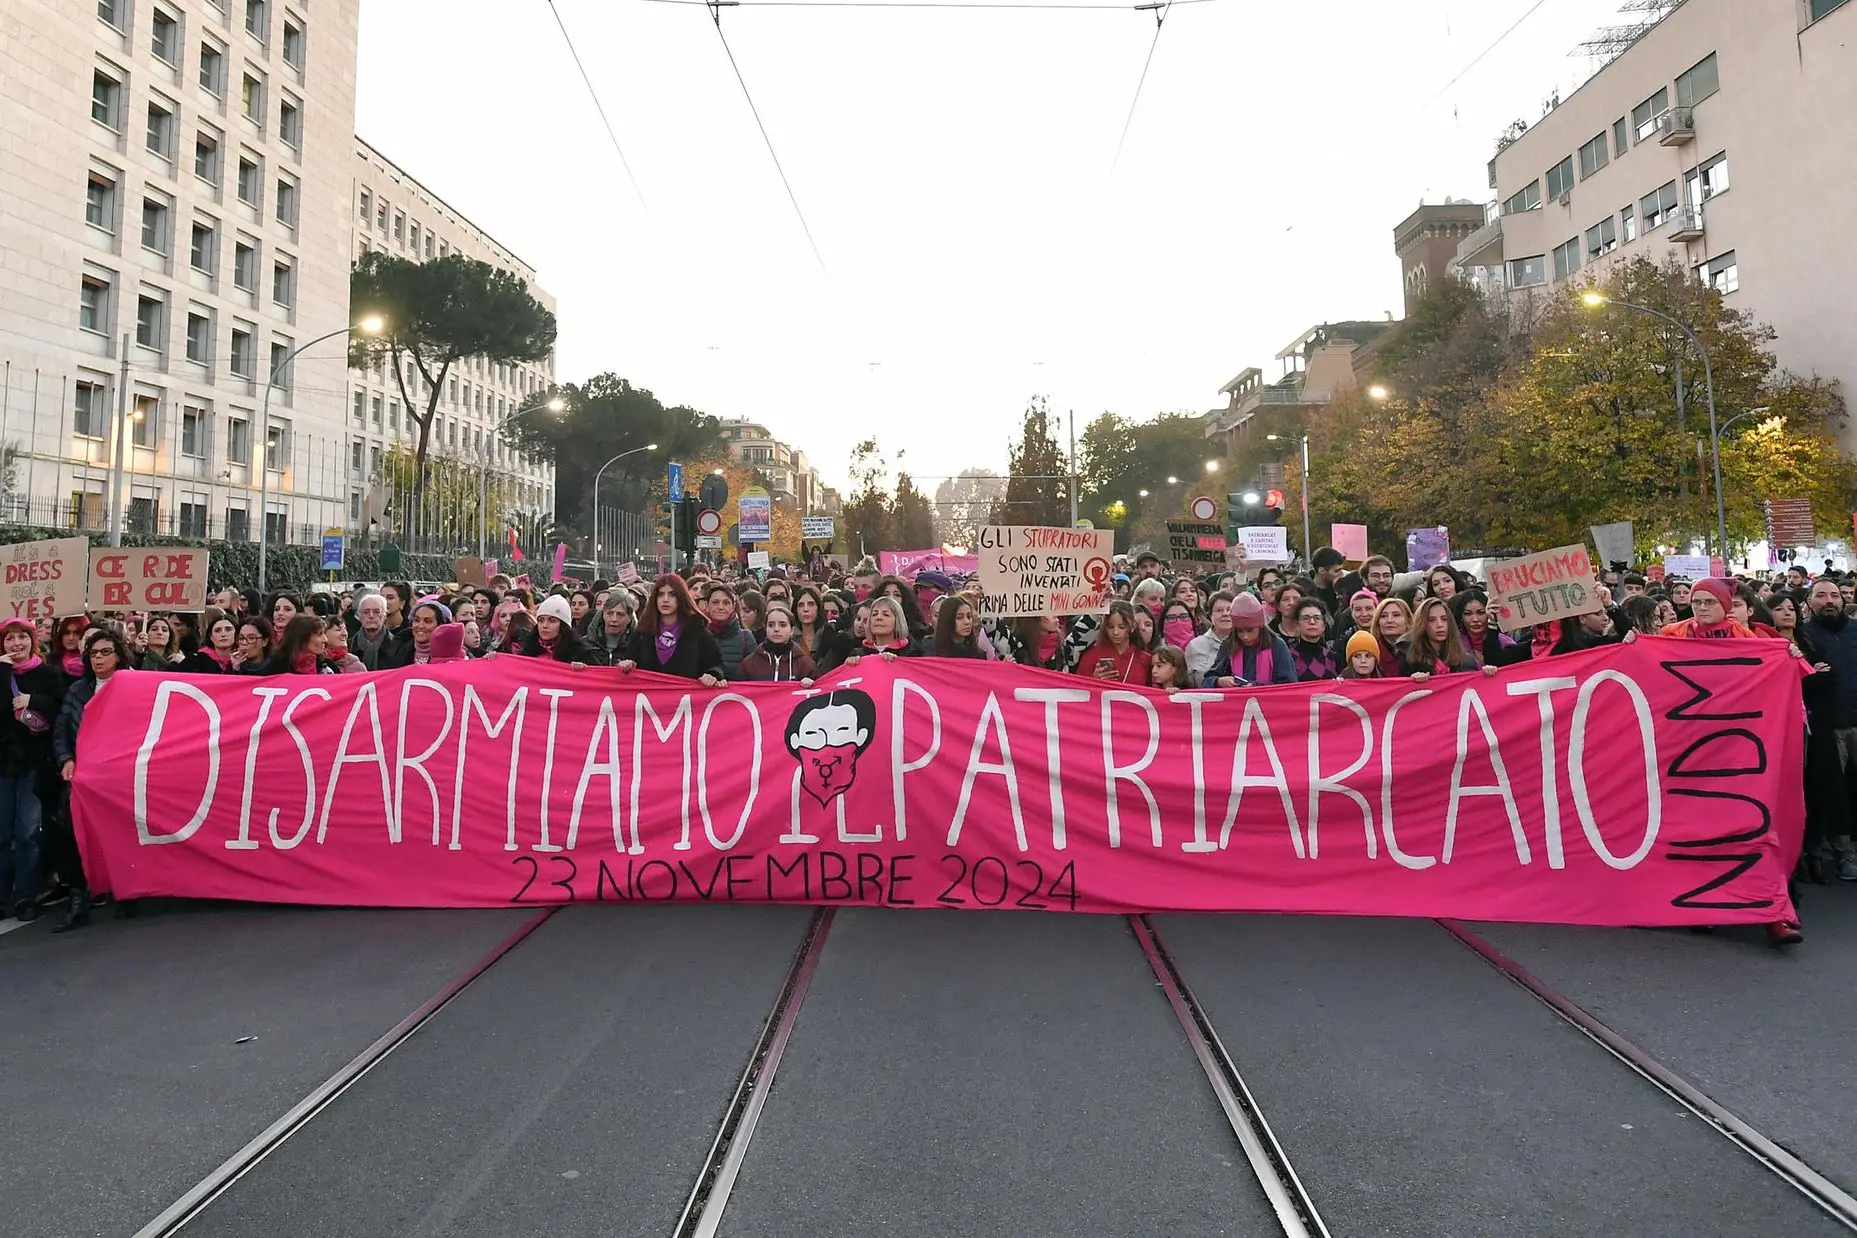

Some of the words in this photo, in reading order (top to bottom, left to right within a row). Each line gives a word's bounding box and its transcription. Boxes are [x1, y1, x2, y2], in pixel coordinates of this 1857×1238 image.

[981, 528, 1012, 548] GLI
[1023, 527, 1098, 549] STUPRATORI
[6, 559, 63, 585] DRESS
[999, 555, 1037, 573] SONO
[1045, 556, 1077, 572] STATI
[12, 581, 39, 600] not
[1020, 573, 1080, 589] INVENTATI
[11, 596, 55, 618] YES
[978, 592, 1008, 615] PRIMA
[1014, 593, 1044, 613] DELLE
[1050, 593, 1070, 611] MINI
[1073, 593, 1106, 610] GONNE
[1508, 582, 1587, 618] TUTTO
[134, 678, 763, 855] DISARMIAMO
[892, 668, 1663, 871] PATRIARCATO
[1660, 657, 1774, 909] NUDM
[510, 855, 577, 903] 23
[596, 851, 916, 905] NOVEMBRE
[936, 854, 1082, 911] 2024
